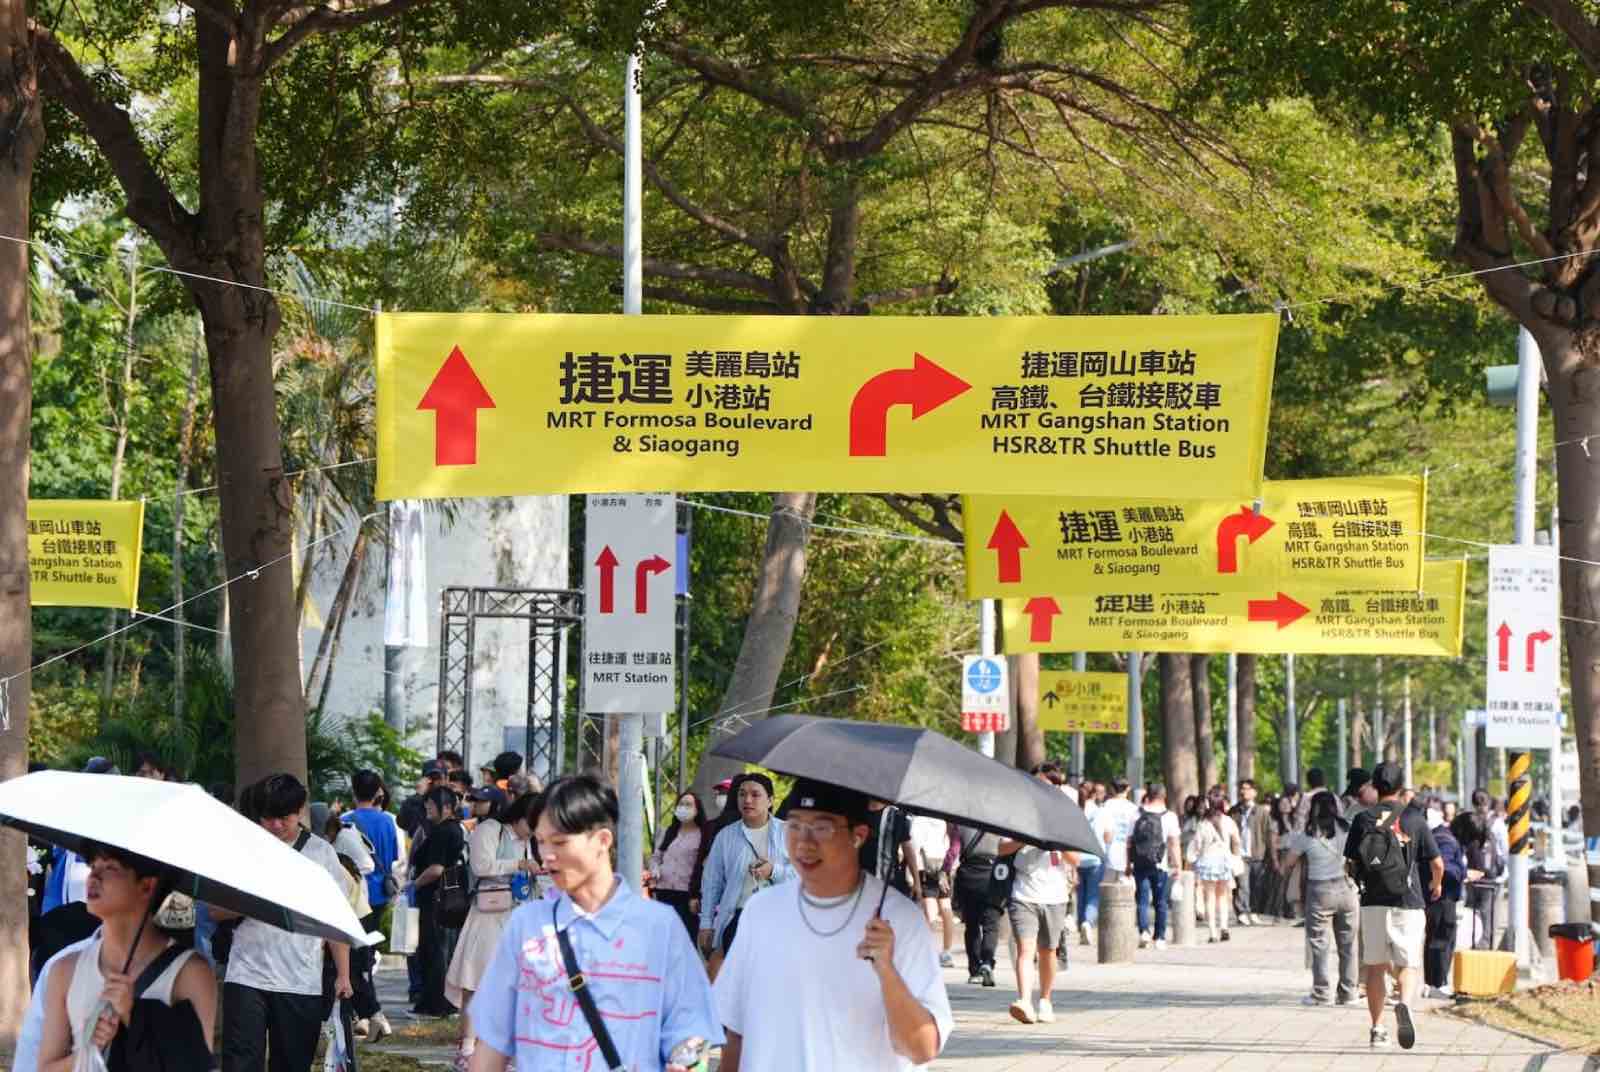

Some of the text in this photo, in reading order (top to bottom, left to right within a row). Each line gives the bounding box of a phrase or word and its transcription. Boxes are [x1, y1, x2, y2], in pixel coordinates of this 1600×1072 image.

[685, 350, 801, 379] 美麗島站
[1021, 348, 1197, 379] 捷運岡山車站
[559, 351, 673, 404] 捷運
[685, 383, 771, 411] 小港站
[991, 381, 1222, 411] 高鐵、台鐵接駁車
[547, 411, 813, 431] MRT Formosa Boulevard
[981, 410, 1230, 434] MRT Gangshan Station
[613, 434, 740, 457] & Siaogang
[993, 435, 1216, 459] HSR&TR Shuttle Bus
[1297, 499, 1388, 518] 捷運岡山車站
[1058, 510, 1123, 545] 捷運
[1128, 527, 1174, 544] 小港站
[1057, 544, 1198, 560] MRT Formosa Boulevard
[1285, 540, 1409, 554] MRT Gangshan Station
[31, 556, 122, 569] angshan Station
[1093, 562, 1160, 576] & Siaogang
[1292, 556, 1405, 569] HSR&TR Shuttle Bus
[52, 571, 94, 583] Shuttle
[96, 573, 117, 584] Bus
[1161, 600, 1205, 614] 小港站
[1088, 615, 1228, 626] MRT Formosa Boulevard
[1315, 615, 1445, 627] MRT Gangshan Station
[1136, 630, 1188, 640] Siaogang
[1375, 628, 1415, 639] Shuttle
[1419, 628, 1439, 639] Bus
[593, 672, 668, 683] MRT Station
